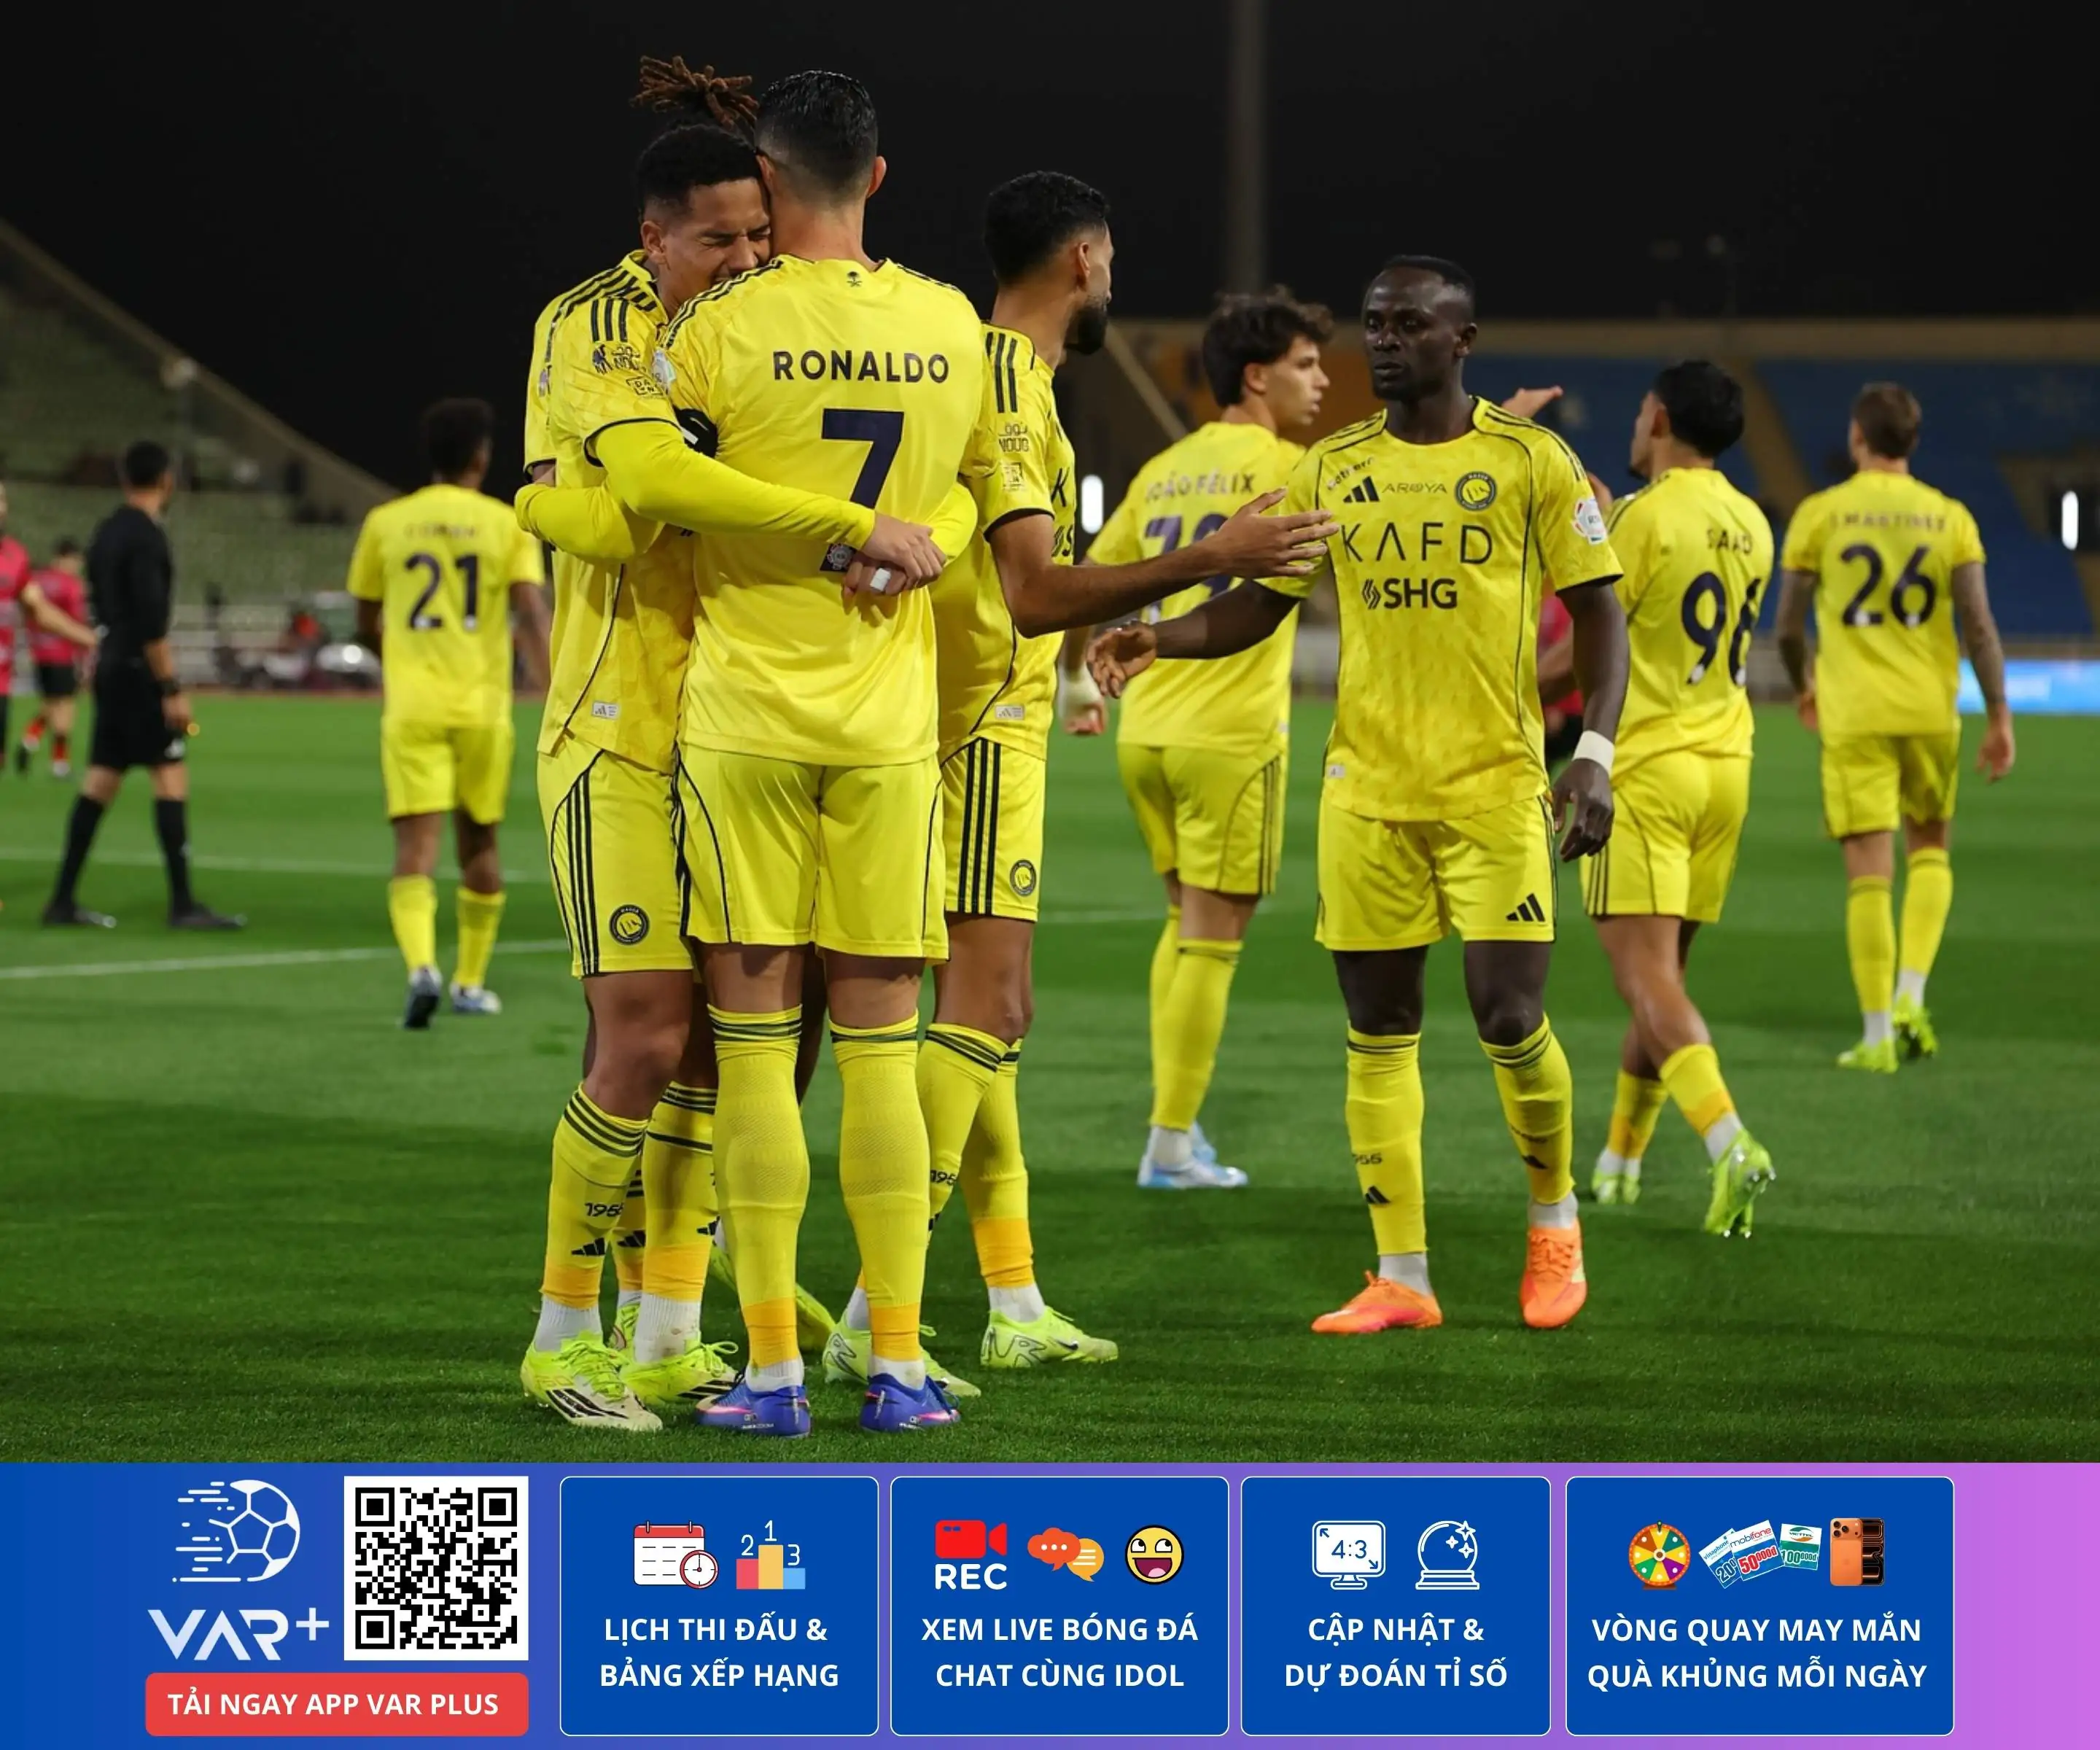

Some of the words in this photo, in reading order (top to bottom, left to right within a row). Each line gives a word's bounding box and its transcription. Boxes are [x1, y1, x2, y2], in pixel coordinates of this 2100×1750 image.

[774, 350, 949, 384] RONALDO
[821, 408, 904, 572] 7
[1340, 522, 1493, 565] KAFD
[405, 553, 478, 630] 21
[1383, 578, 1458, 610] SHG
[1841, 544, 1936, 629] 26
[1681, 571, 1762, 686] 96
